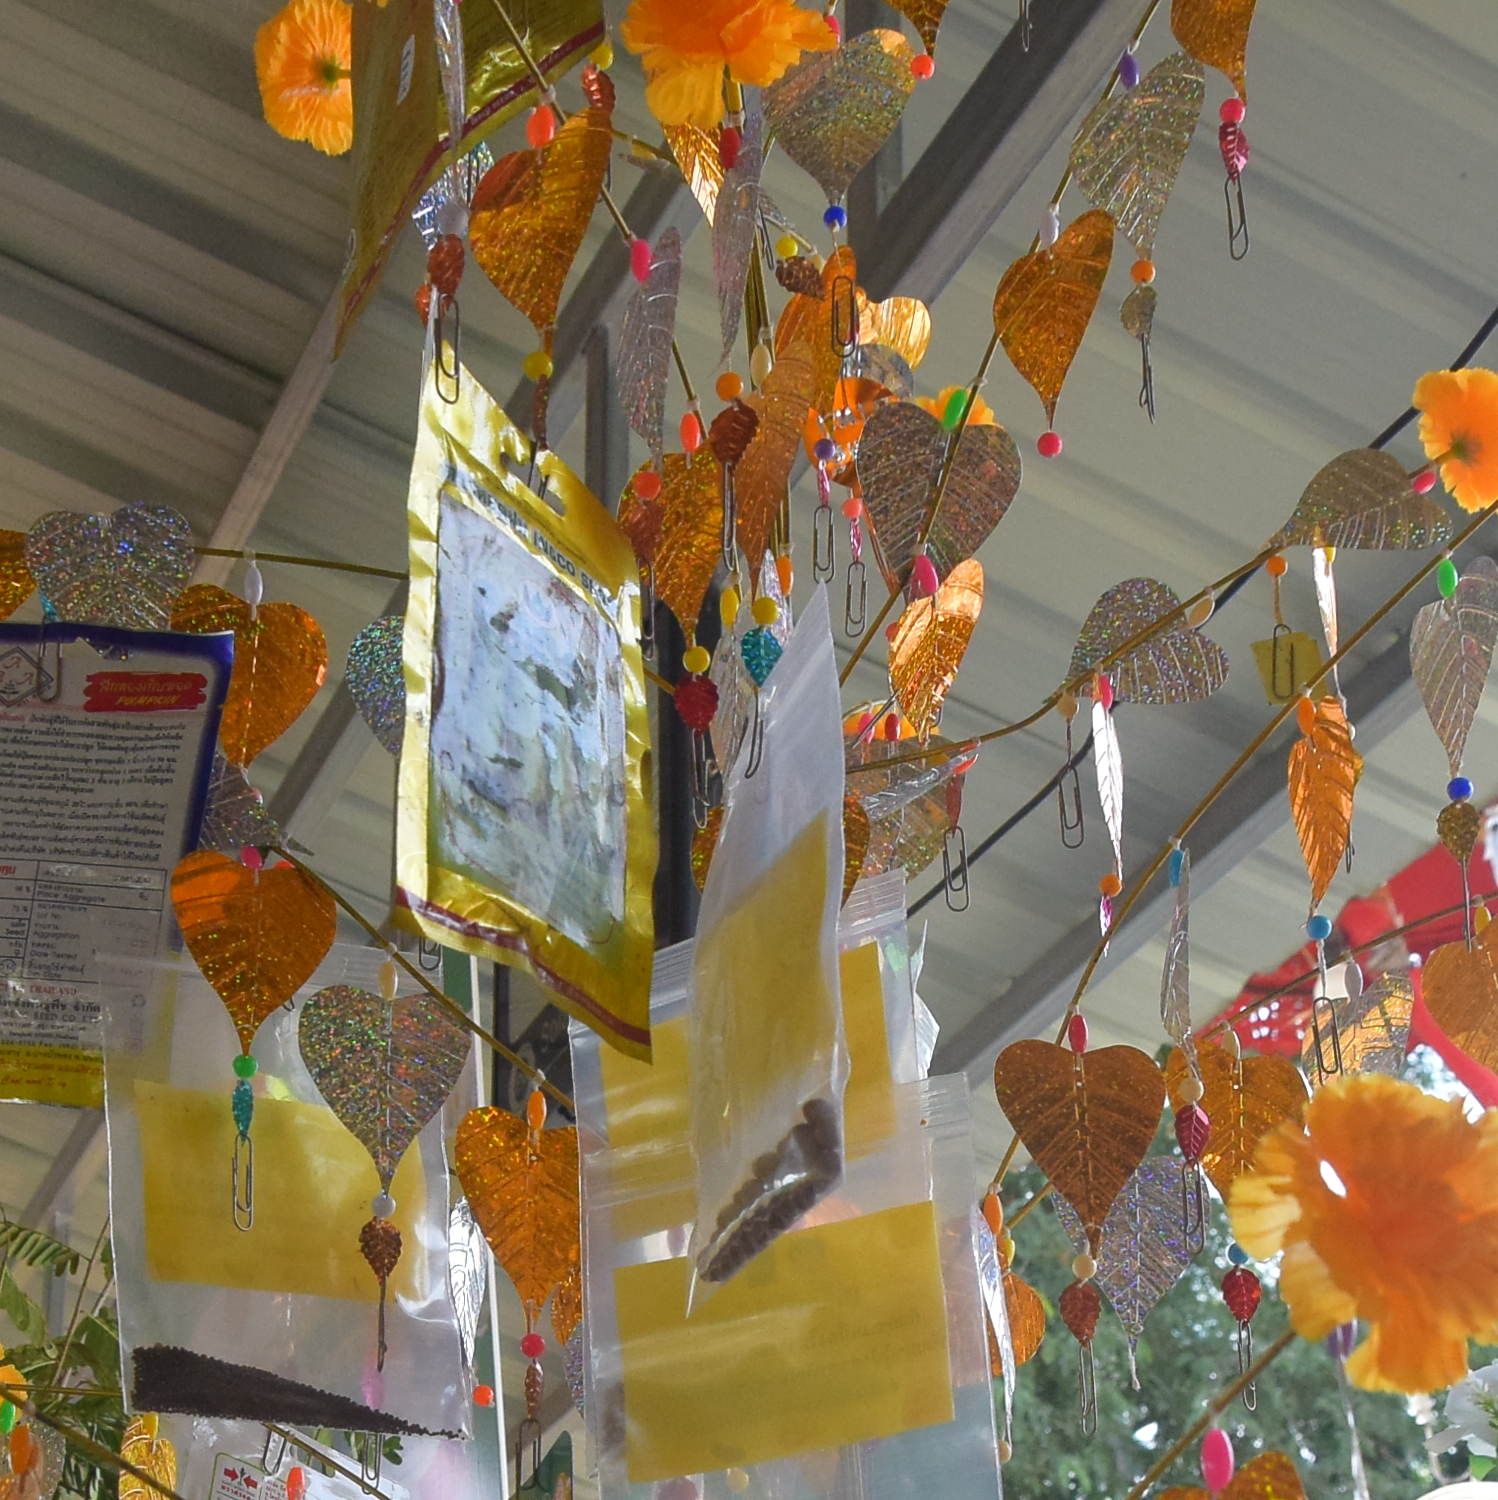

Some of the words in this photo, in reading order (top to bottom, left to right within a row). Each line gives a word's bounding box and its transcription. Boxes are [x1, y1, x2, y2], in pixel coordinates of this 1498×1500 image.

[115, 694, 182, 706] PUMPKIN
[29, 984, 77, 996] THAILAND
[34, 1011, 58, 1021] SEED
